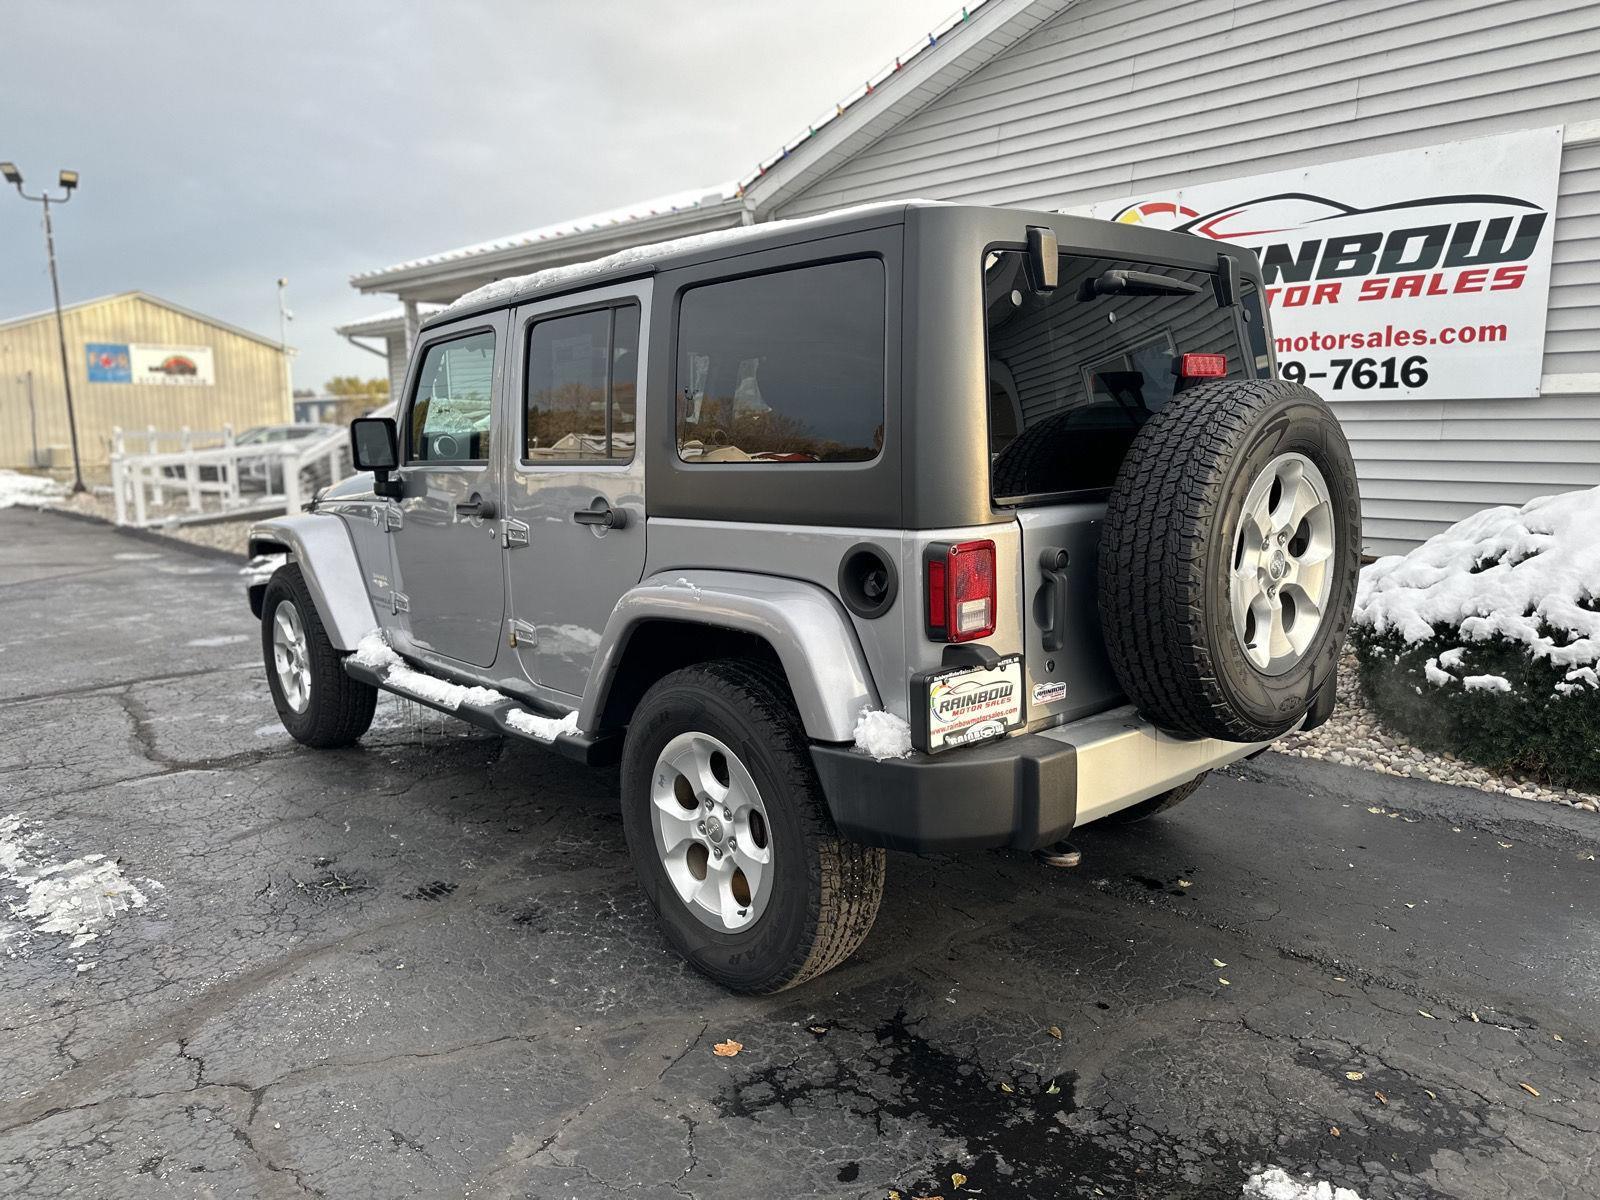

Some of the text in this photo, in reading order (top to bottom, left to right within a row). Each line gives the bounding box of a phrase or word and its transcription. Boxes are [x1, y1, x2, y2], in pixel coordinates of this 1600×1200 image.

[1249, 212, 1548, 285] NBOW
[1265, 265, 1528, 310] TOR SALES
[1275, 324, 1508, 352] motorsales.com
[1277, 355, 1429, 391] 9-7616
[940, 685, 1014, 714] RAINBOW
[952, 696, 1012, 717] MOTOR SALES
